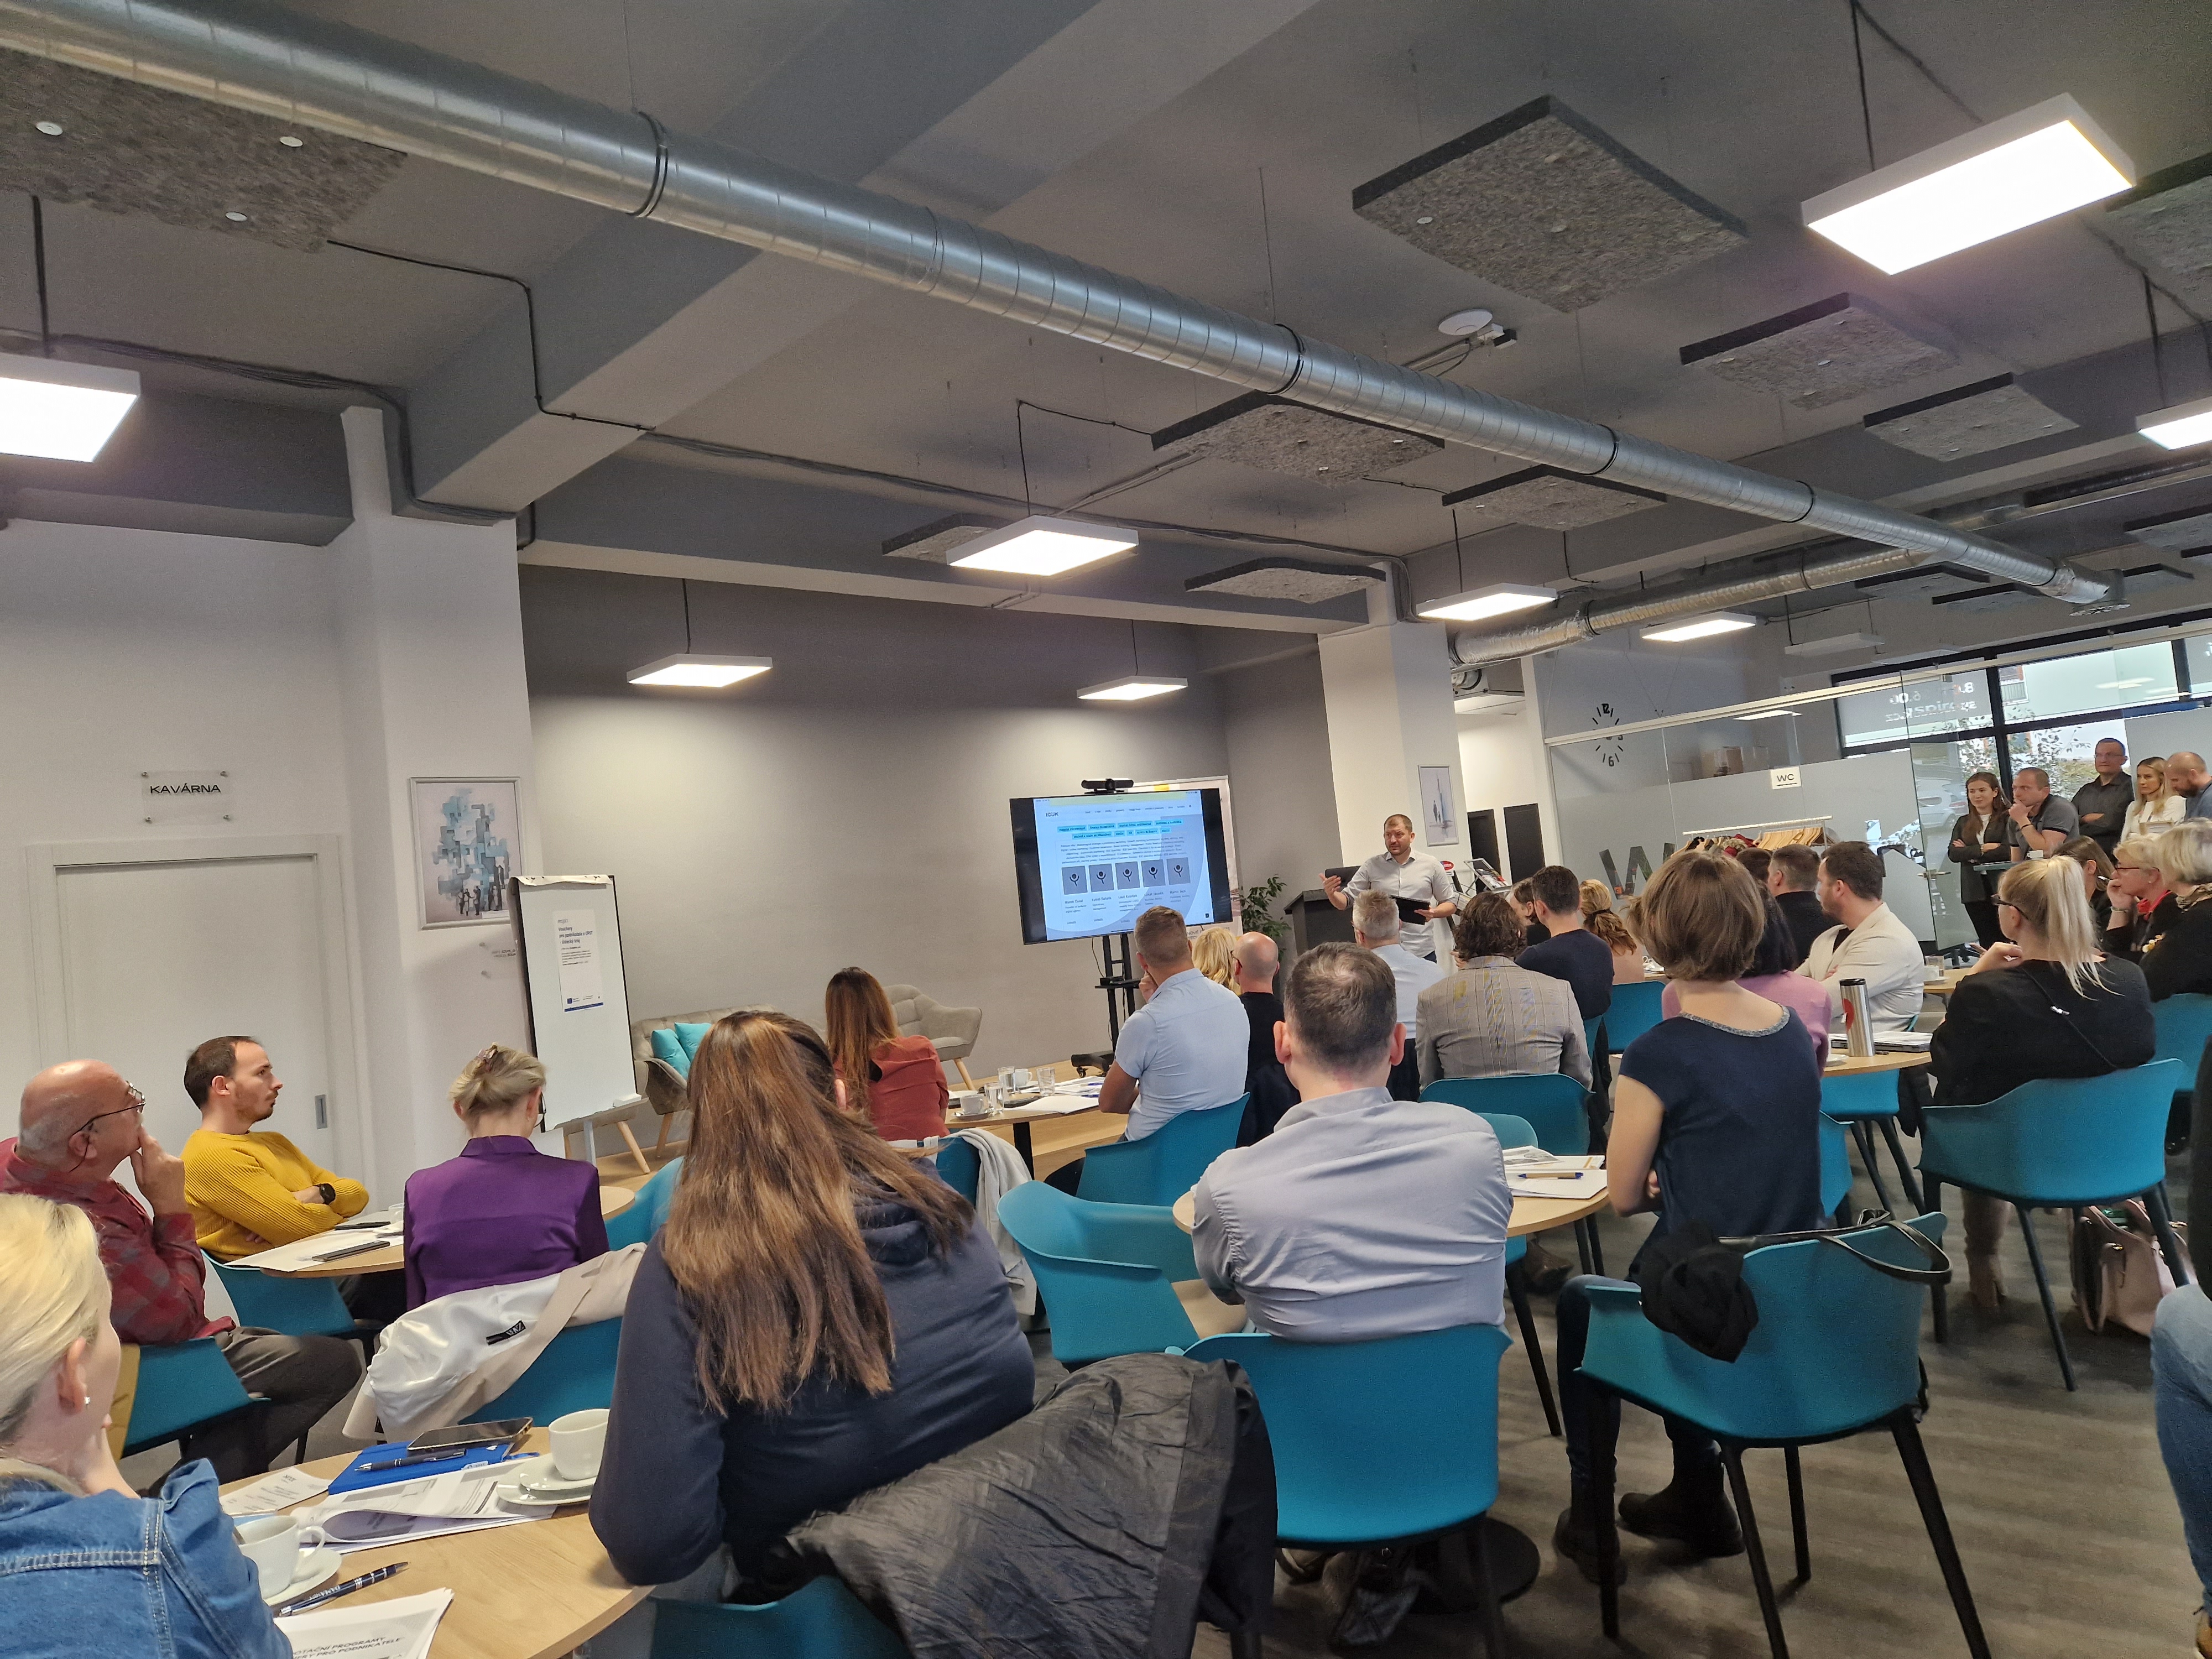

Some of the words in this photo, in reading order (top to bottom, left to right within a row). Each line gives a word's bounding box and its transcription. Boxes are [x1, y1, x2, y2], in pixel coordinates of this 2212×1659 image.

[1608, 756, 1614, 767] 6
[150, 782, 221, 794] KAVÁRNA
[331, 1637, 385, 1649] PROGRAMY
